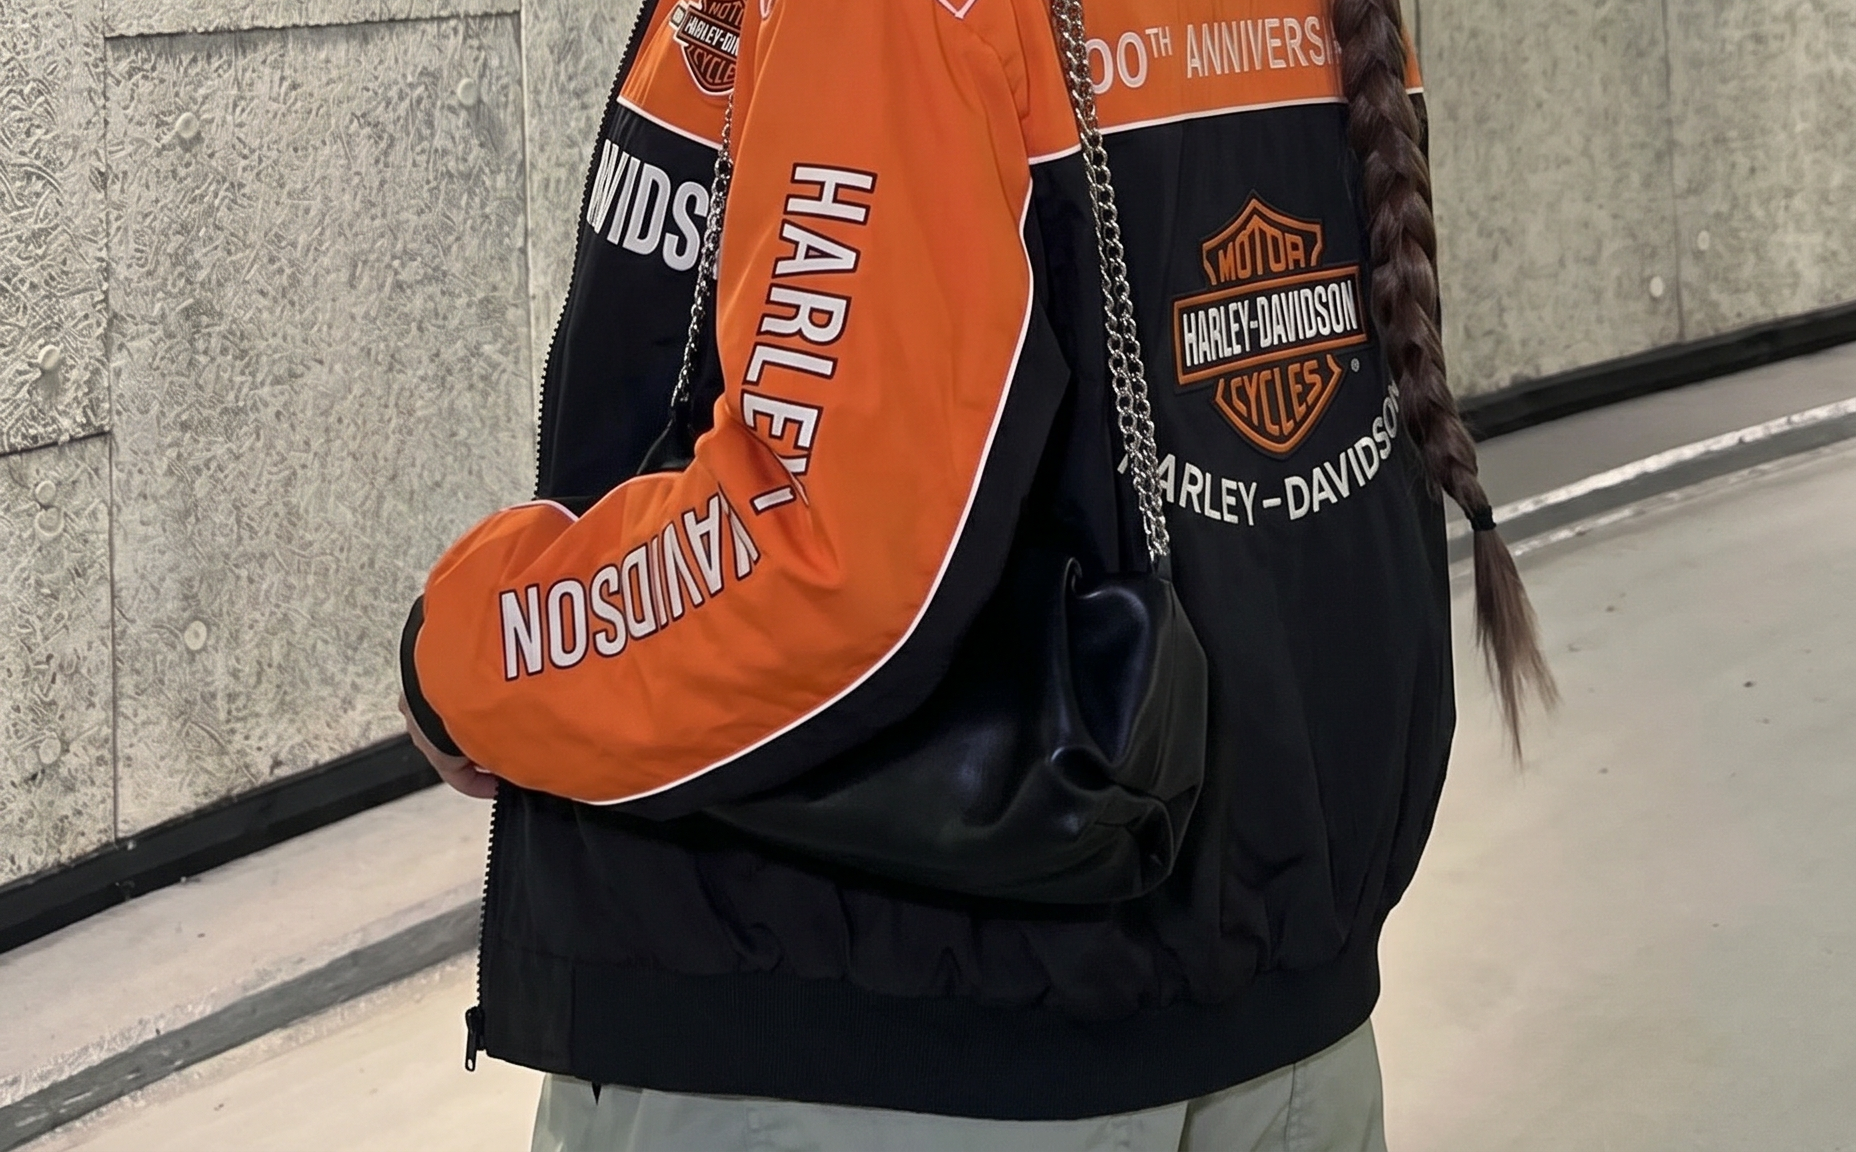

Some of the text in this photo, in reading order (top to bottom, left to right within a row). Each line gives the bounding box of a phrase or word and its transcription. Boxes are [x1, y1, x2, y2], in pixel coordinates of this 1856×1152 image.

[693, 48, 737, 84] CYCLE
[1218, 213, 1306, 283] MOTOR
[1181, 279, 1358, 367] HARLEY-DAVIDSON
[1230, 359, 1323, 437] CYCLES
[1117, 379, 1399, 526] ARLEY-DAVIDSON
